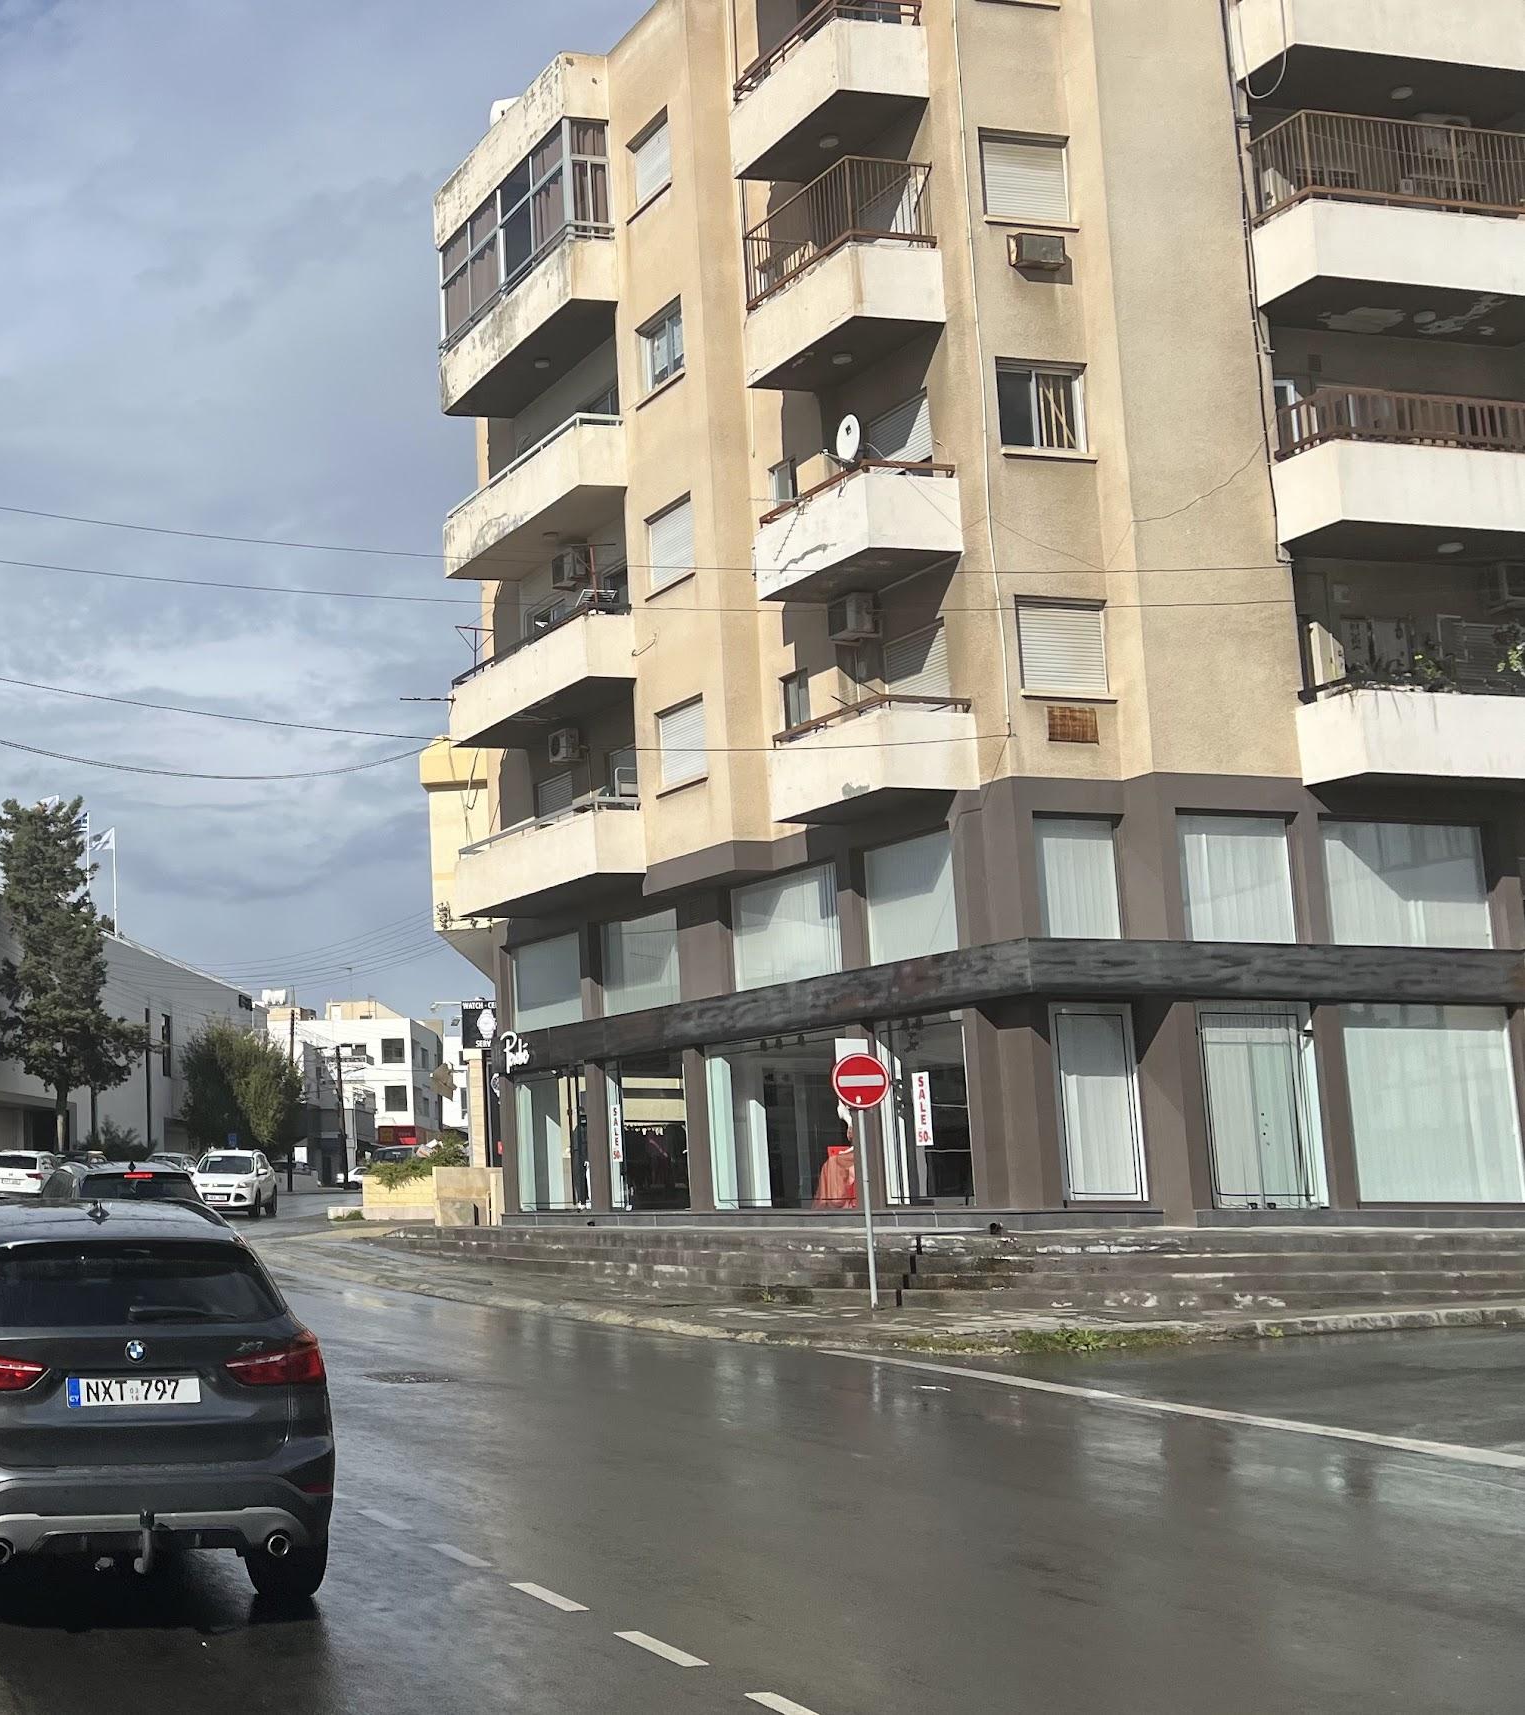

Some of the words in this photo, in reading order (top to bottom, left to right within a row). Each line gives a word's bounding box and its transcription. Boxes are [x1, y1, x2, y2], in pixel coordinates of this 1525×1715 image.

[462, 1002, 483, 1010] WATCH
[475, 1040, 492, 1048] SERV
[918, 1075, 927, 1126] SALE
[85, 1379, 128, 1403] NXT
[140, 1379, 181, 1401] 797
[69, 1395, 79, 1403] CY
